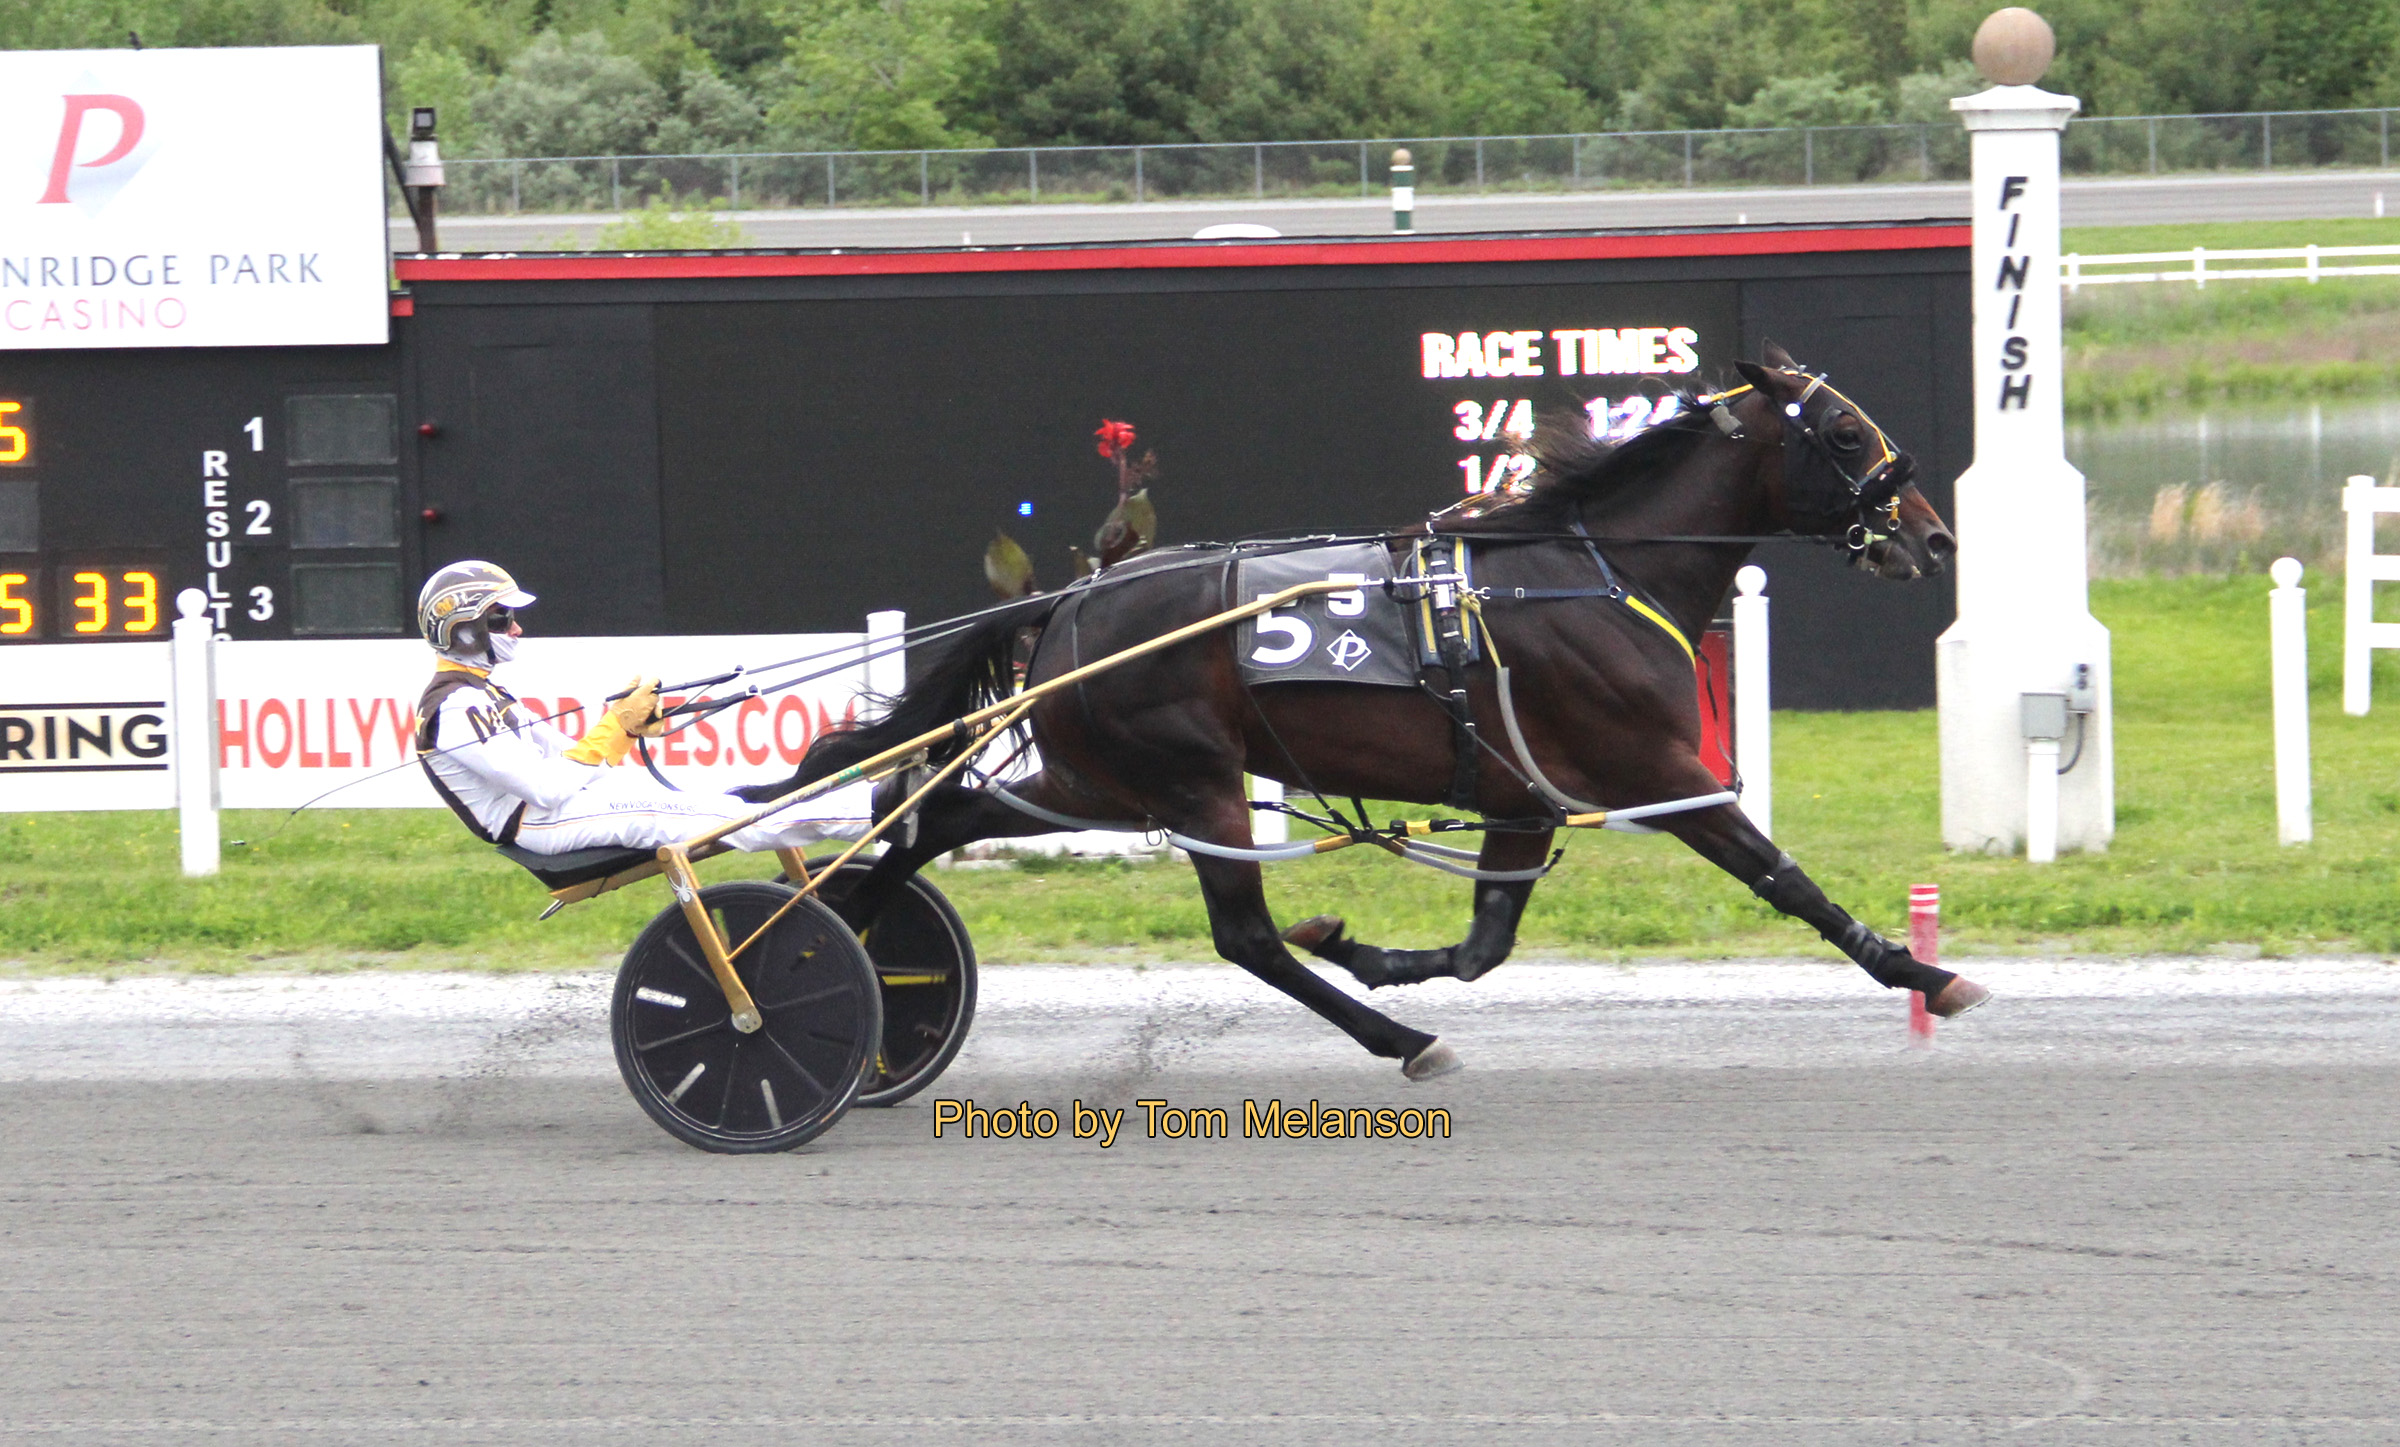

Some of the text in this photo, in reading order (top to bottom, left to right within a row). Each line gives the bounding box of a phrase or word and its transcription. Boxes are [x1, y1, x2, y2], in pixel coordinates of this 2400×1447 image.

[36, 94, 146, 204] P
[2, 253, 323, 288] NRIDGE PARK
[5, 297, 187, 331] CASINO
[1997, 176, 2032, 411] FINISH
[1421, 327, 1699, 379] RACE TIMES
[244, 416, 264, 451] 1
[1453, 399, 1535, 441] 3/4
[1457, 453, 1537, 494] 1/2
[245, 500, 272, 535] 2
[0, 572, 158, 634] 5 33
[248, 586, 274, 621] 3
[1251, 593, 1312, 664] 5
[0, 714, 168, 760] RING
